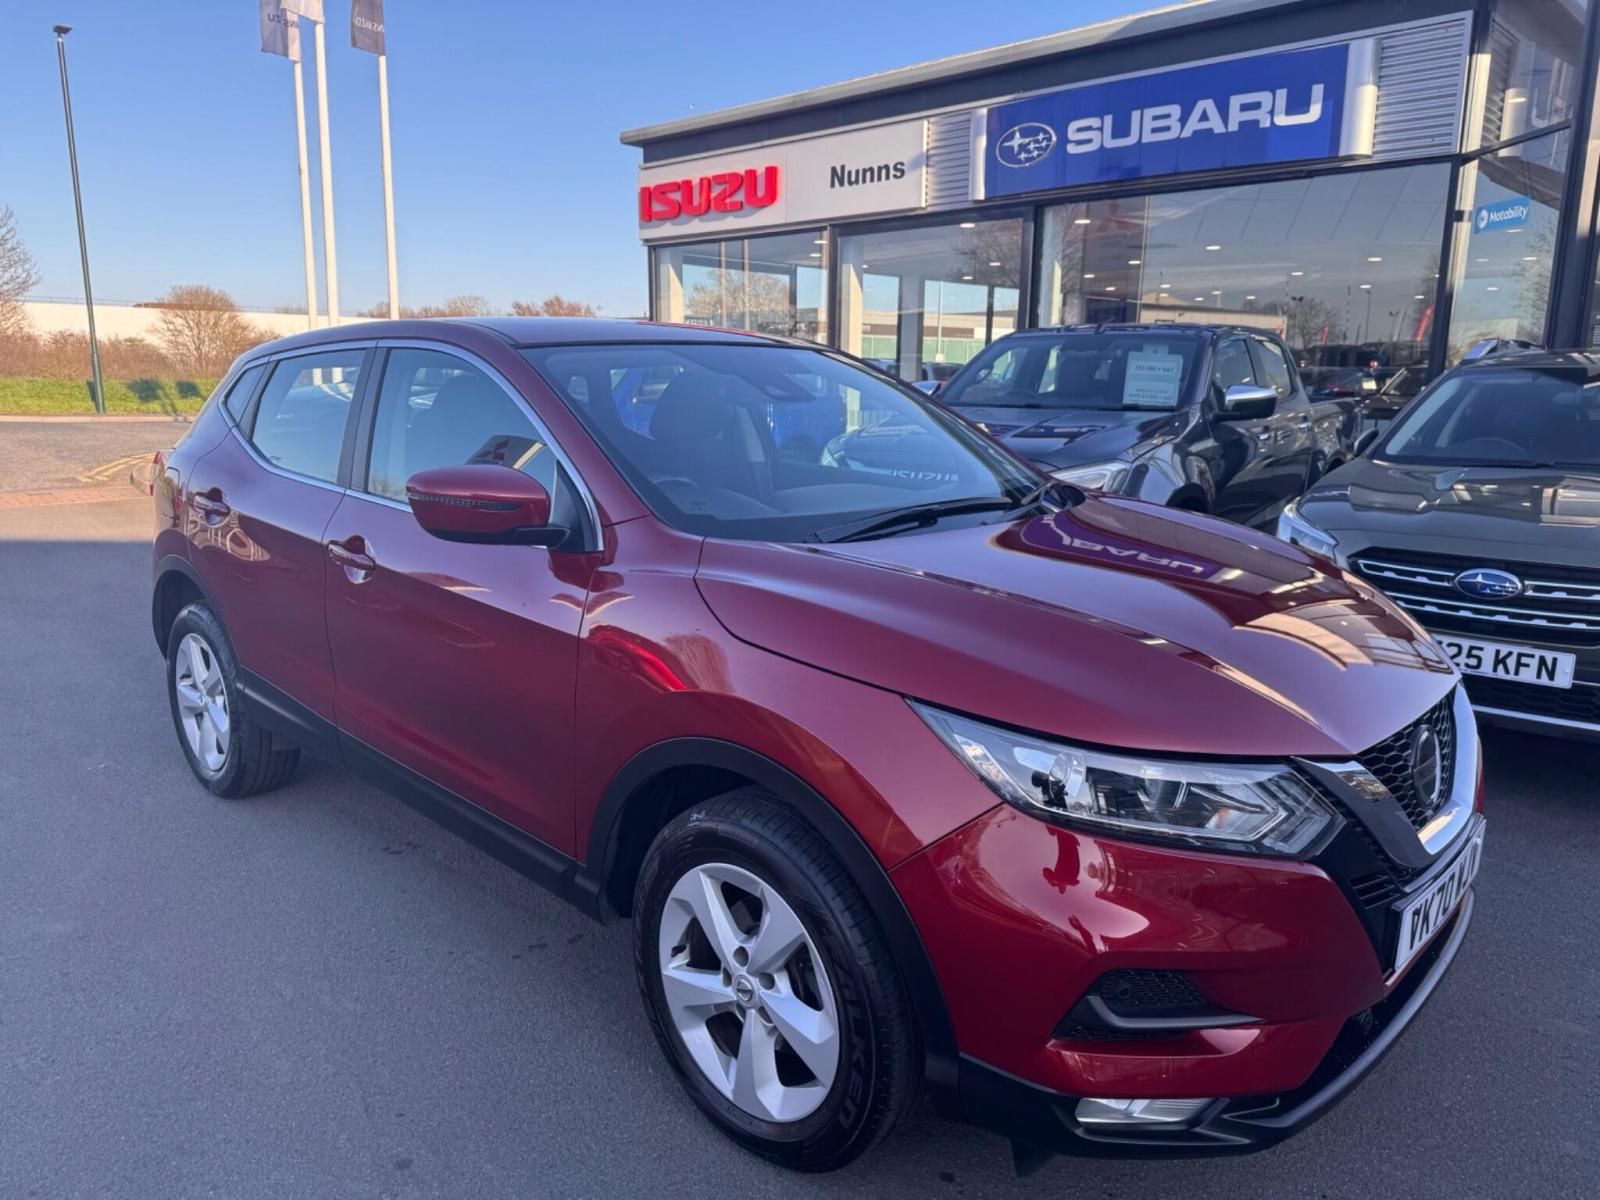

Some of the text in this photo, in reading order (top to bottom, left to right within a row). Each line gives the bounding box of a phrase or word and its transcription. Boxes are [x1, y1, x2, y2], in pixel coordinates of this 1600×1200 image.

[1066, 83, 1324, 154] SUBARU
[640, 165, 778, 221] ISUZU
[830, 161, 906, 189] Nunns
[1489, 206, 1529, 222] Motability
[1437, 640, 1558, 682] 25 KFN
[1410, 871, 1456, 950] PK70
